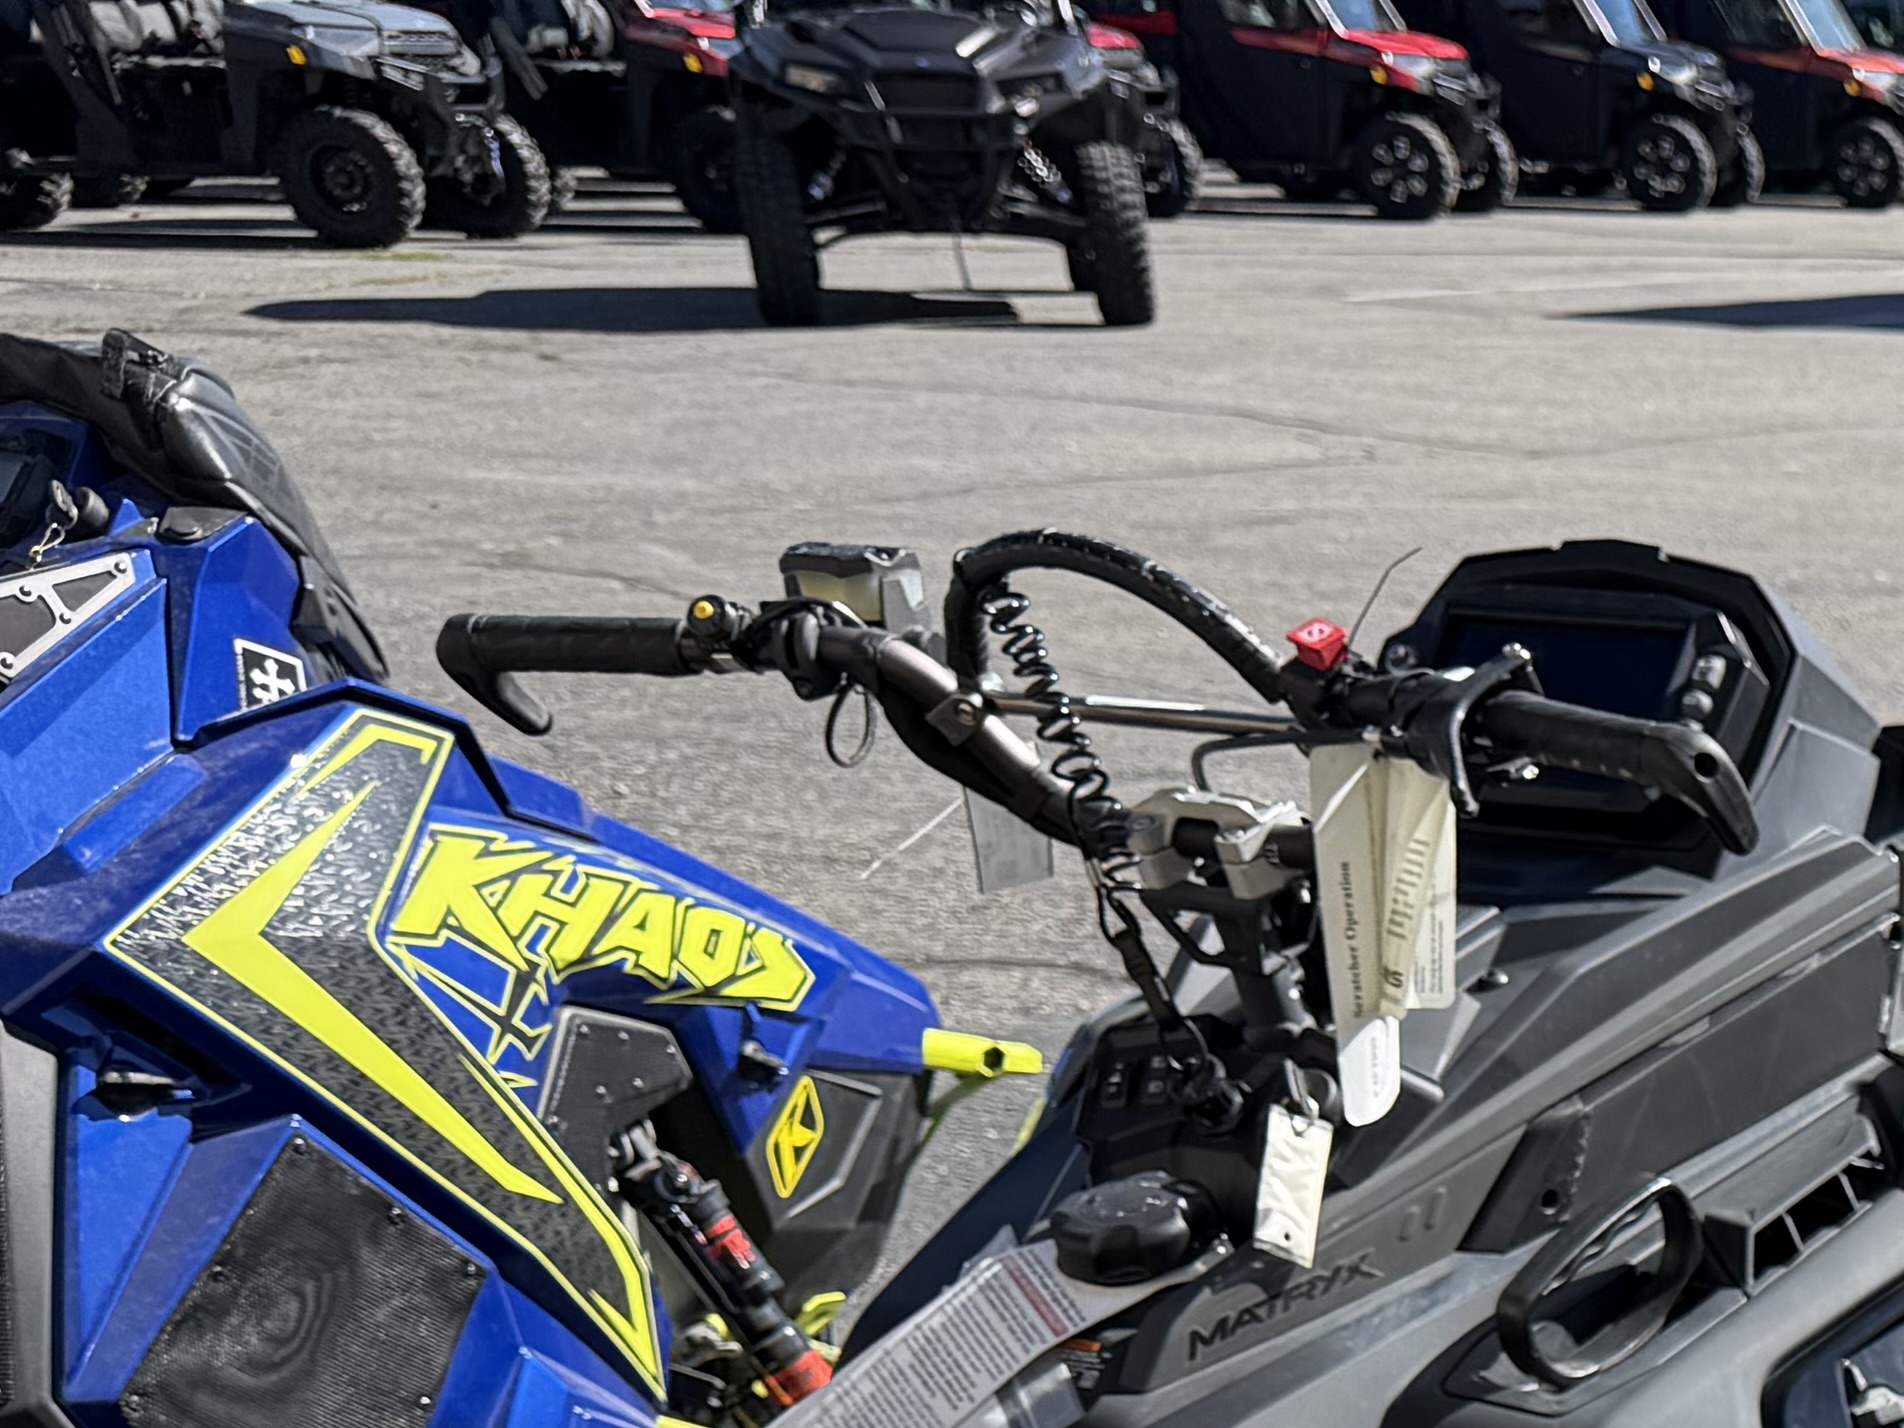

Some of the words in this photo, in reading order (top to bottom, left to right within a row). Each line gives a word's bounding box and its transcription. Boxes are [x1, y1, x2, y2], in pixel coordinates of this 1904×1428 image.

[391, 825, 815, 1011] KHAOS
[1339, 860, 1358, 942] Operation
[1187, 1248, 1386, 1361] MATRYX
